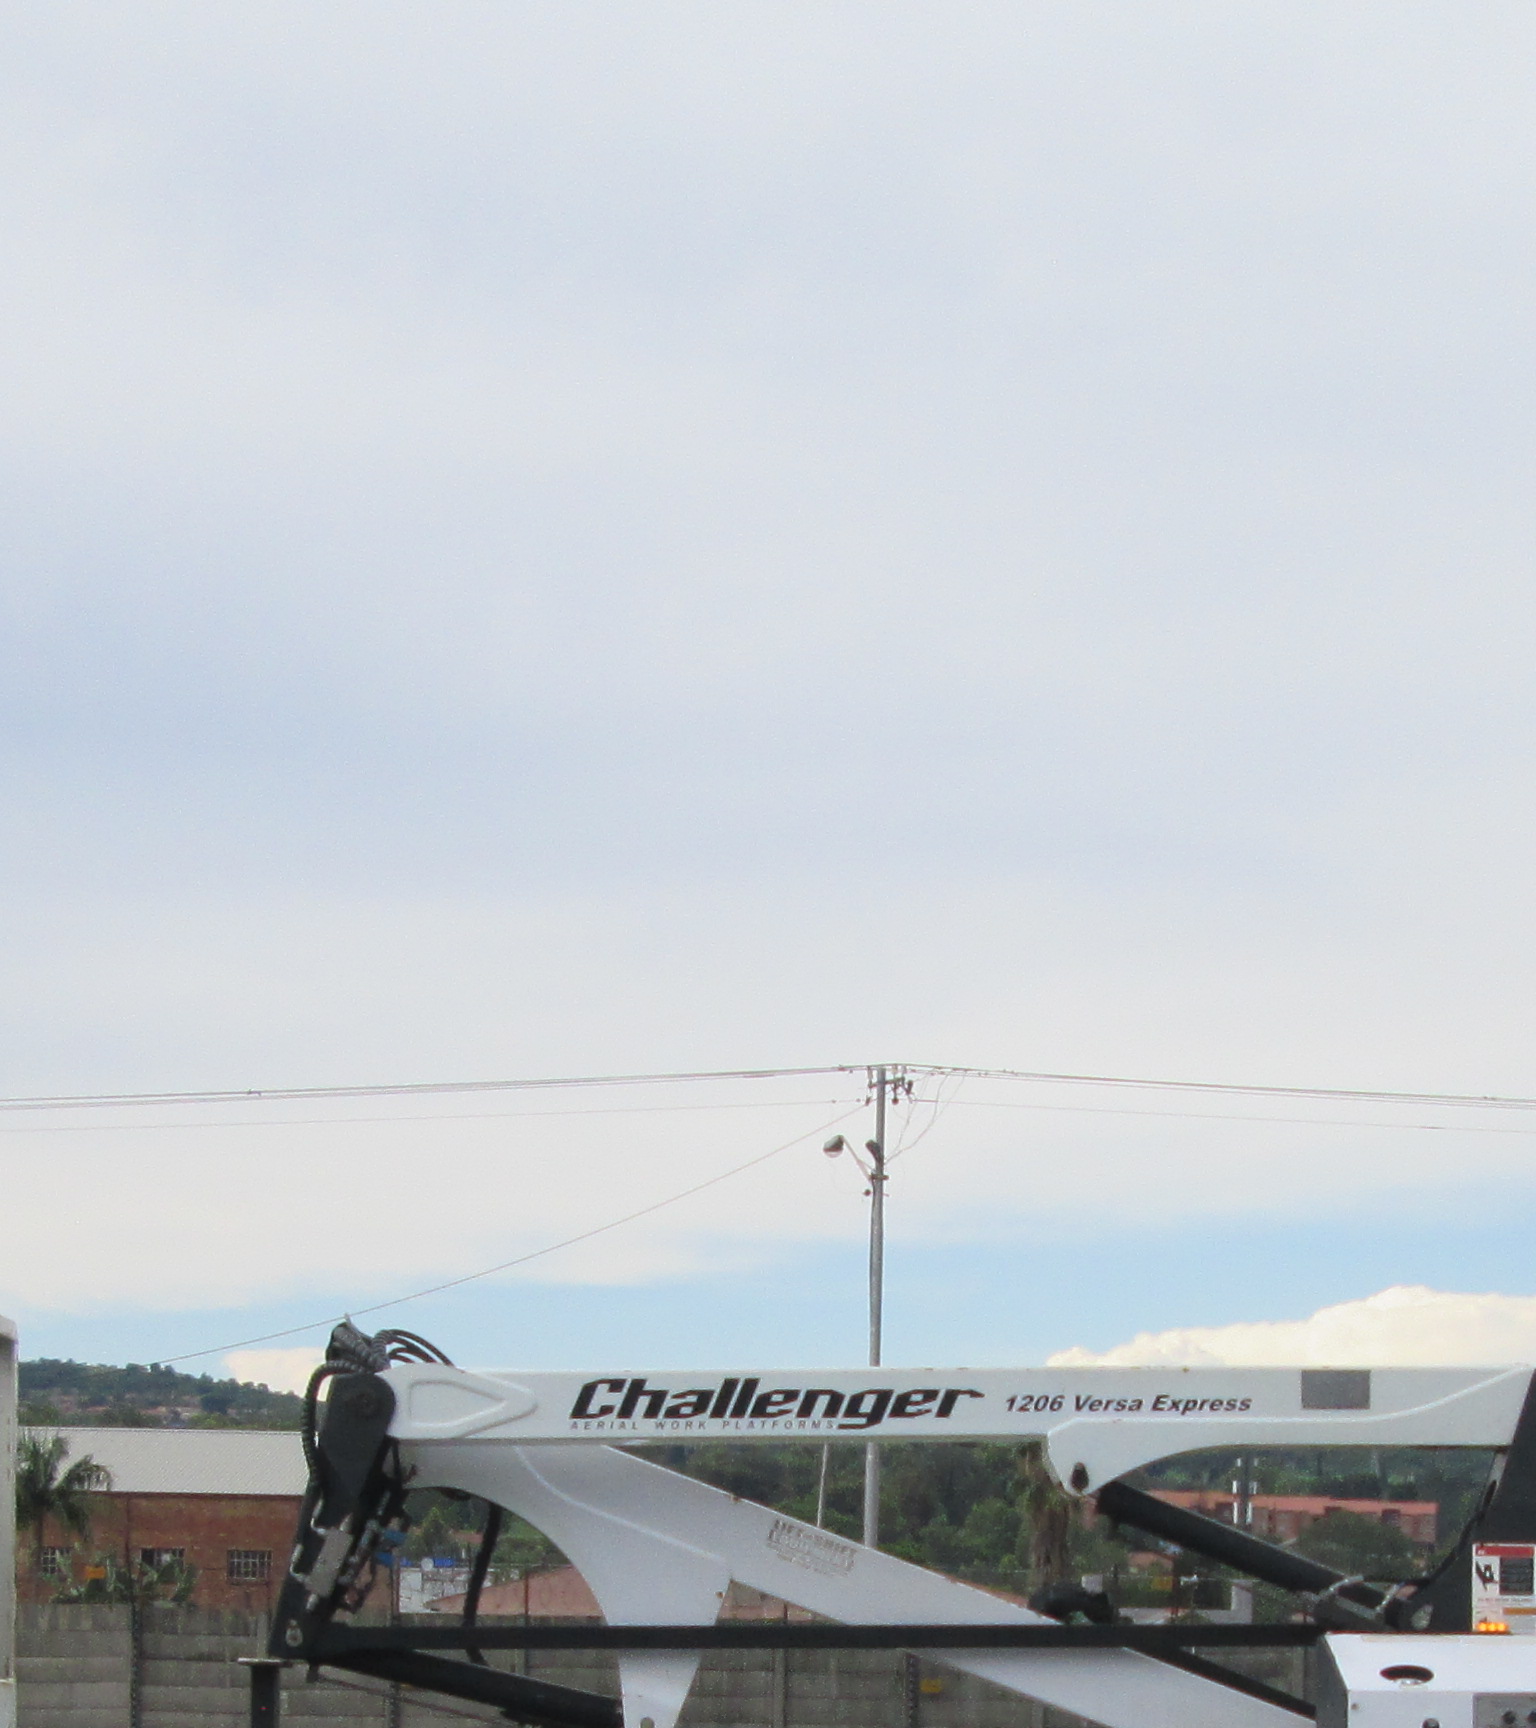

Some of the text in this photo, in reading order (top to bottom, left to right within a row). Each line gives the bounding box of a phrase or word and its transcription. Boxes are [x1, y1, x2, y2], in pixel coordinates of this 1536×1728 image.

[569, 1377, 985, 1430] Challenger
[1005, 1394, 1253, 1416] 1206 Versa Express
[569, 1419, 836, 1431] AERIAL WORK PLATFORMS
